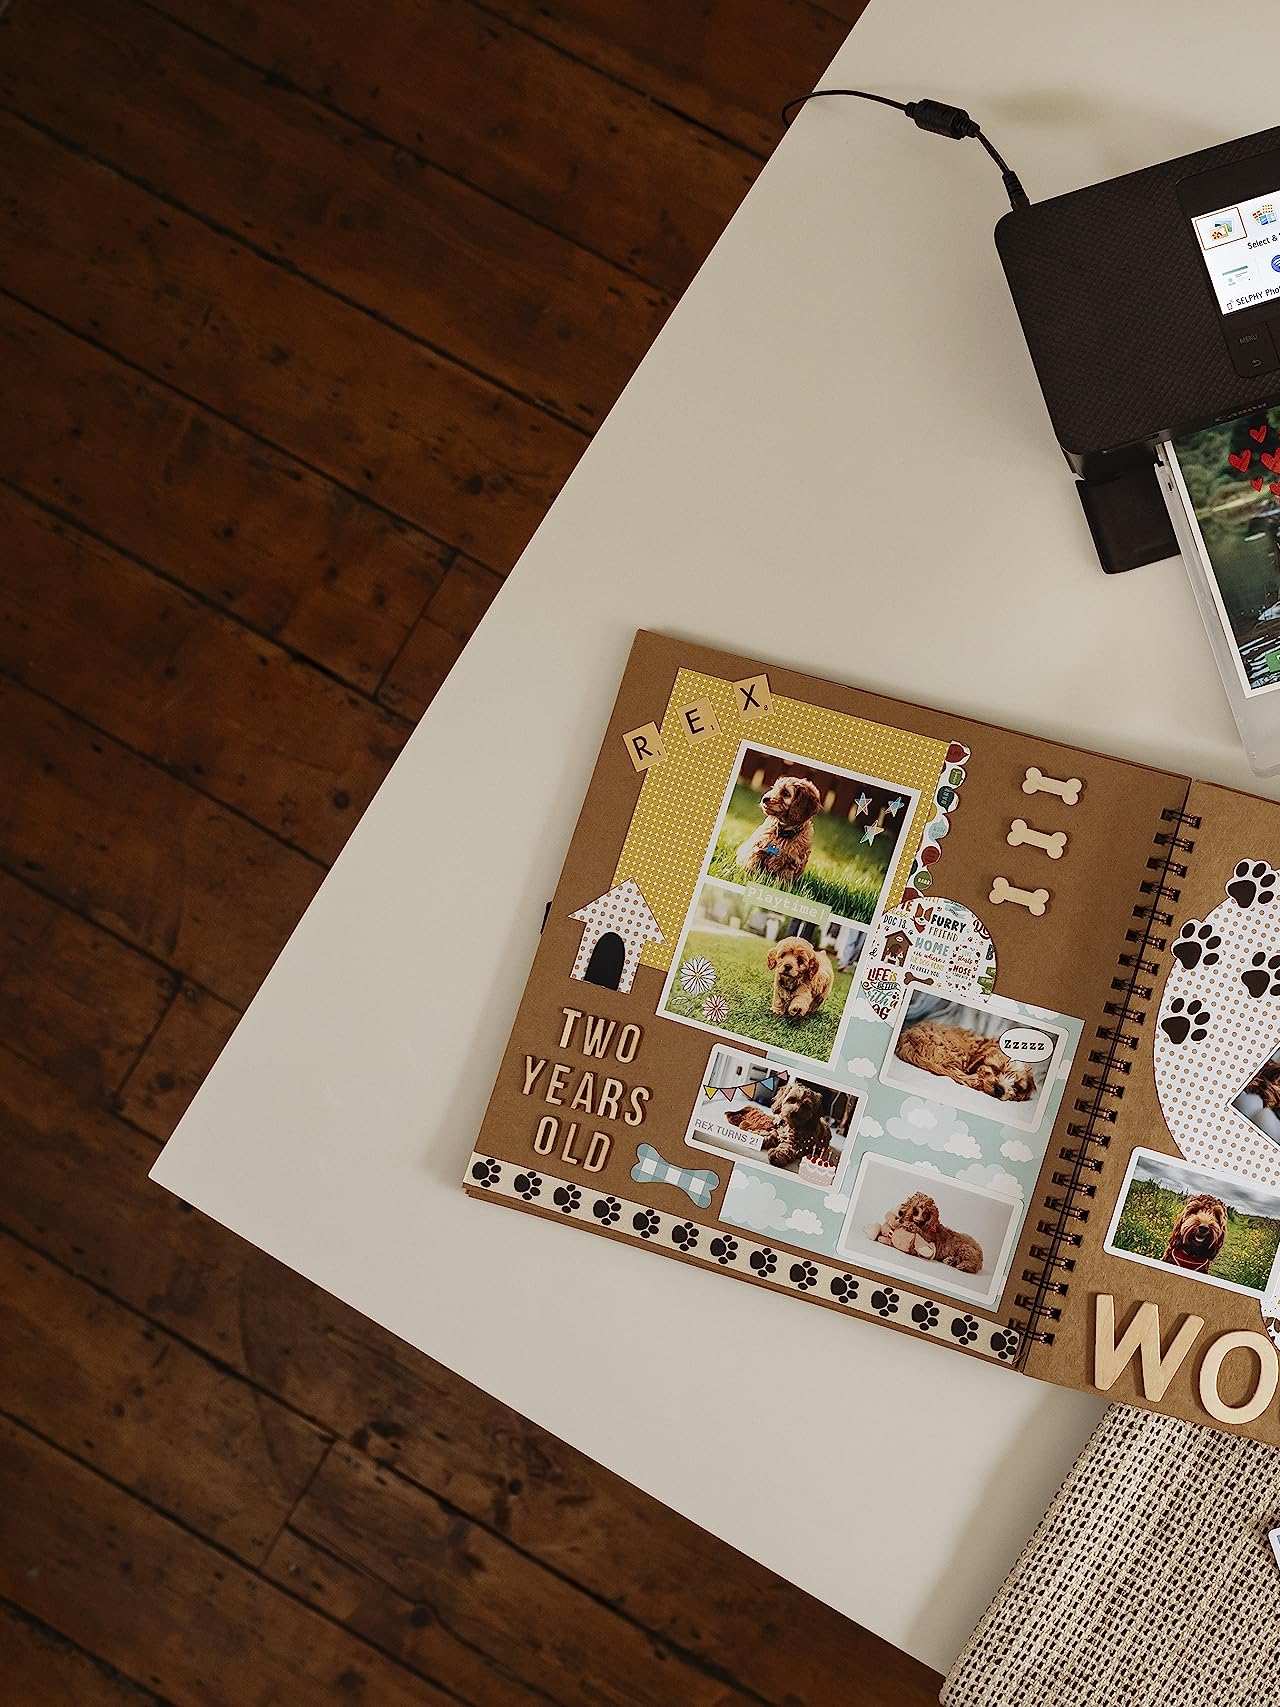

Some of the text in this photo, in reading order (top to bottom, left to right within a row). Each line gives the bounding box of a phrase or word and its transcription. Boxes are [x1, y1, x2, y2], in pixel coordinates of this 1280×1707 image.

[1247, 236, 1271, 250] Select
[1236, 291, 1264, 307] SELPHY
[931, 914, 967, 933] FURRY
[928, 926, 959, 943] FRIEND
[915, 936, 950, 957] HOME
[867, 967, 892, 981] LIFE
[559, 1007, 642, 1064] TWO
[1003, 1038, 1047, 1051] Zzzzz
[522, 1055, 651, 1127] YEARS
[694, 1118, 714, 1132] REX
[716, 1125, 748, 1143] TURNS
[533, 1115, 612, 1173] OLD
